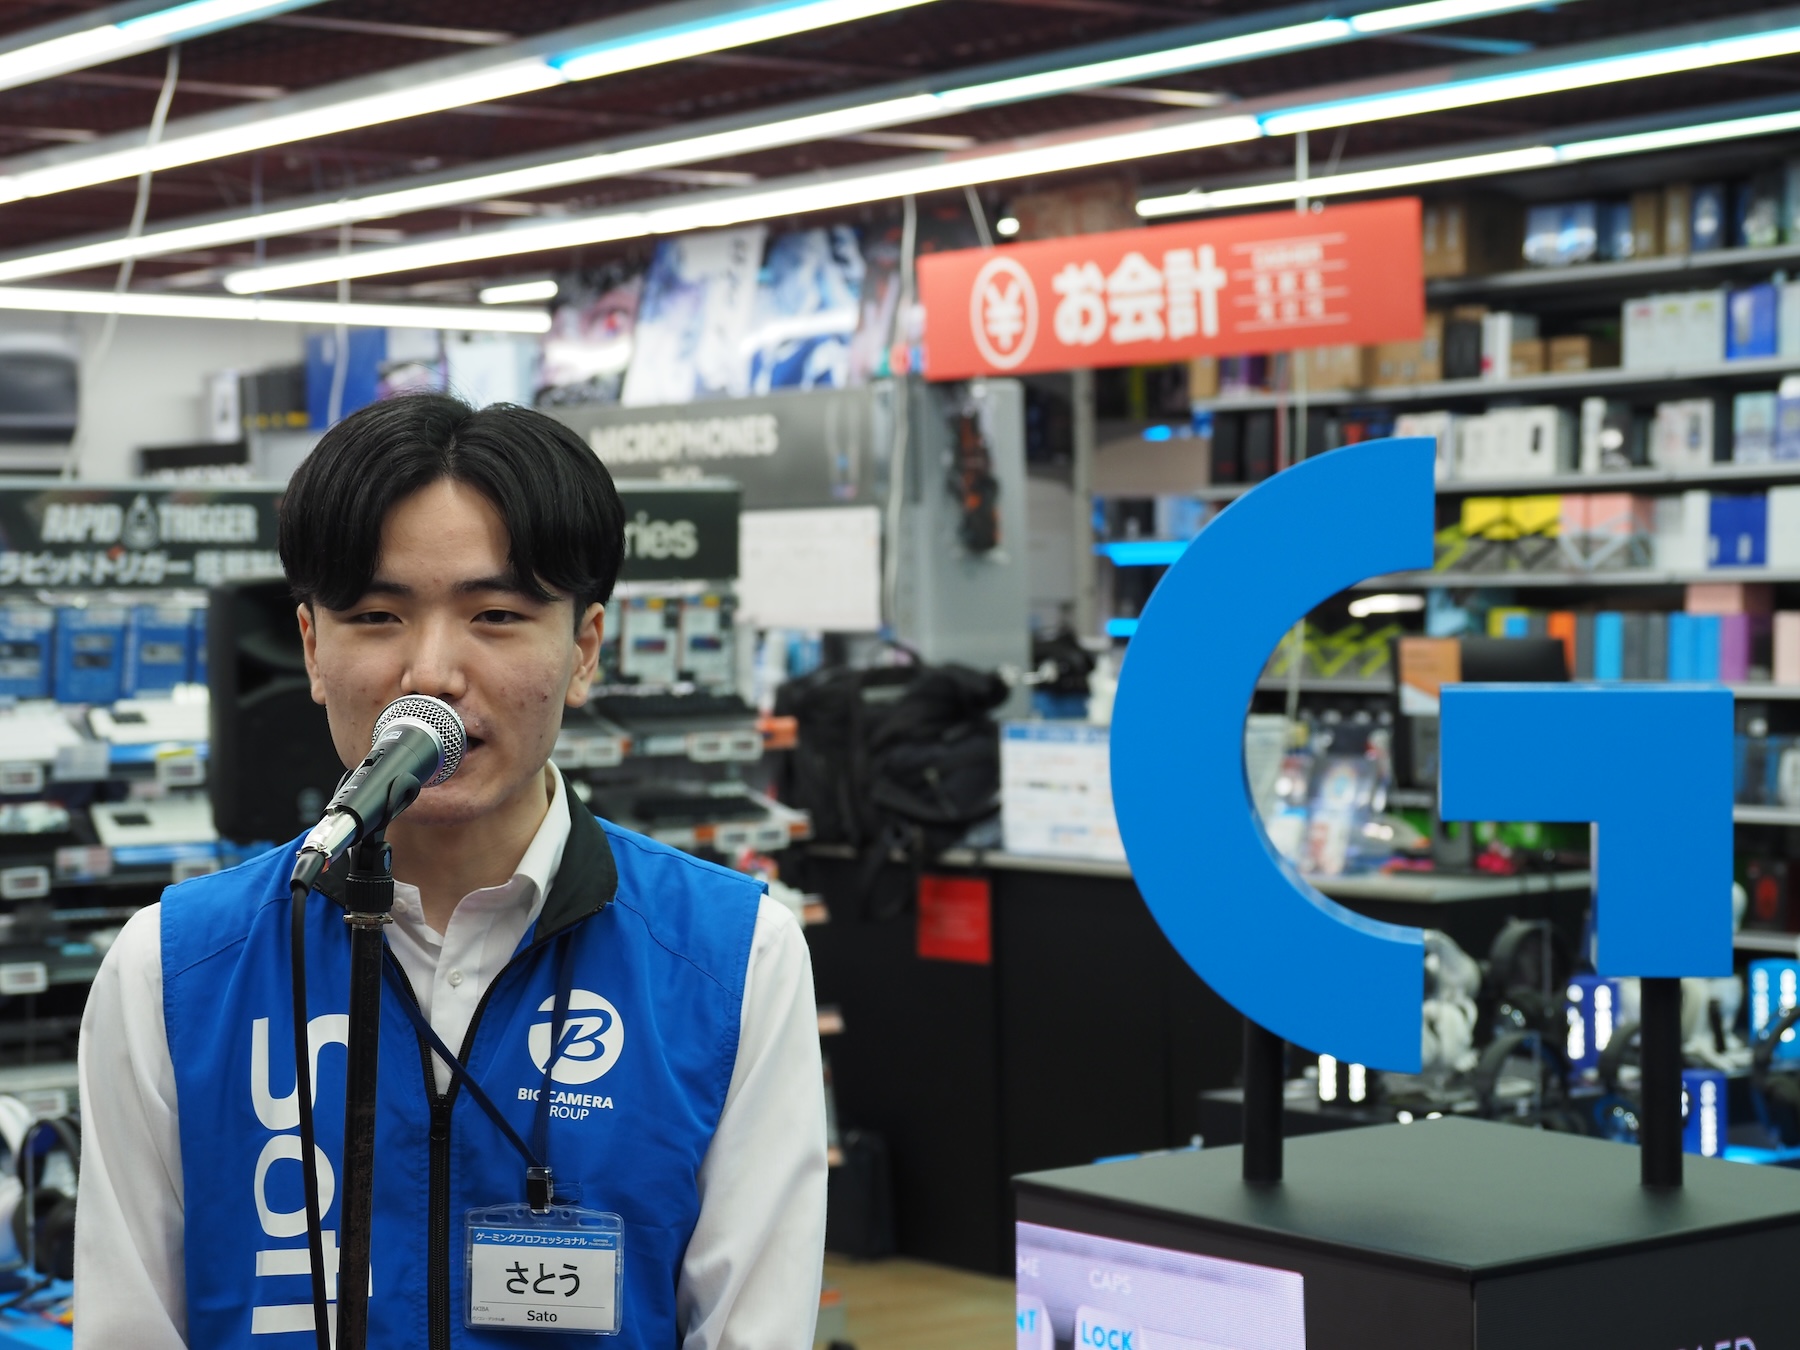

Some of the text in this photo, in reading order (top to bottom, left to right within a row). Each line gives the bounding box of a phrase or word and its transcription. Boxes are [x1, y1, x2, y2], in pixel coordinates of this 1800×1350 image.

[1052, 243, 1227, 345] お会計
[590, 413, 778, 462] MICROPHONES
[41, 503, 259, 543] RAPID TRIGGER
[548, 1091, 614, 1109] CAMERA
[549, 1105, 589, 1121] ROUP
[475, 1232, 588, 1246] ゲーミングプロフェッショナル
[505, 1261, 580, 1298] さとう
[1088, 1269, 1131, 1294] CAPS
[526, 1310, 558, 1322] Sato
[1082, 1320, 1133, 1350] LOCK
